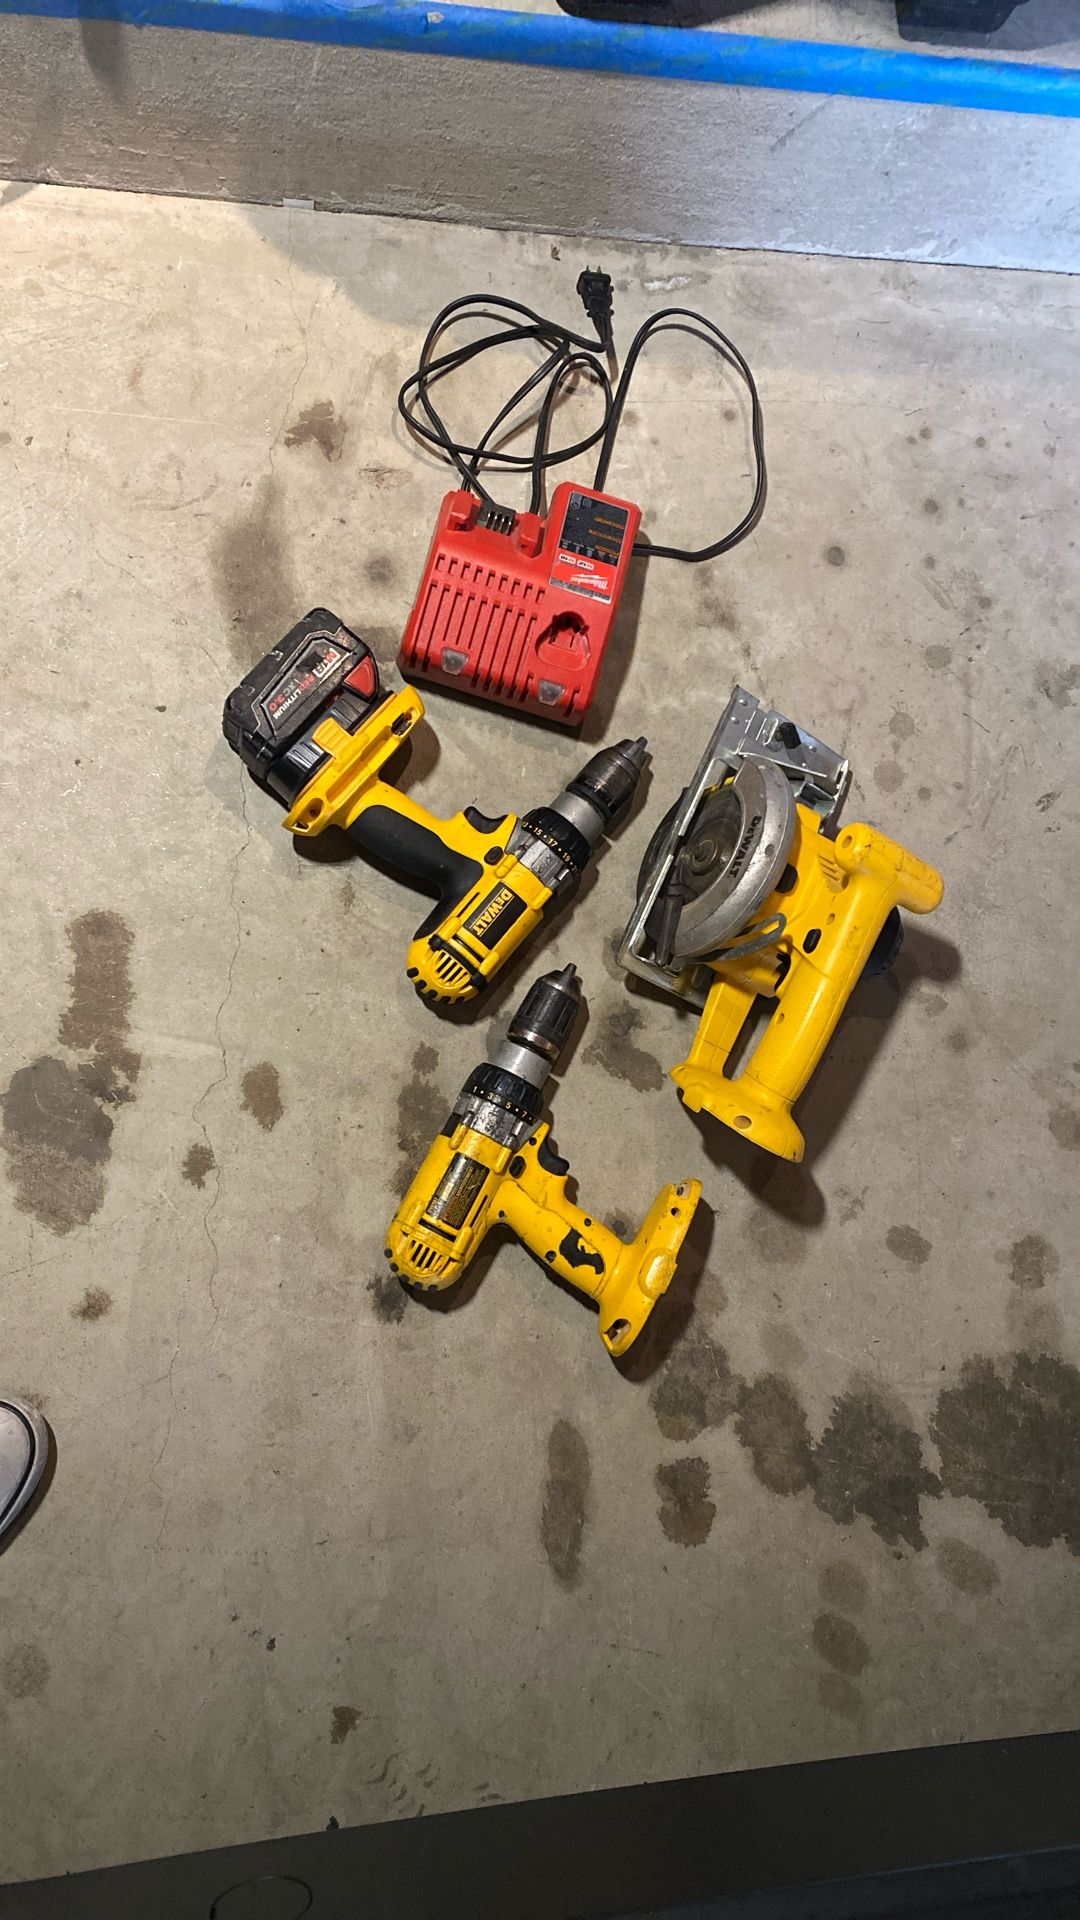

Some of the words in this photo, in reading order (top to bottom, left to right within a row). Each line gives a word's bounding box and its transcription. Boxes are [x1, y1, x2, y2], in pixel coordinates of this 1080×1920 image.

[533, 827, 543, 836] 15
[548, 837, 558, 847] 17
[562, 852, 571, 862] 19
[729, 816, 763, 878] DEWALT
[487, 1092, 493, 1100] 3
